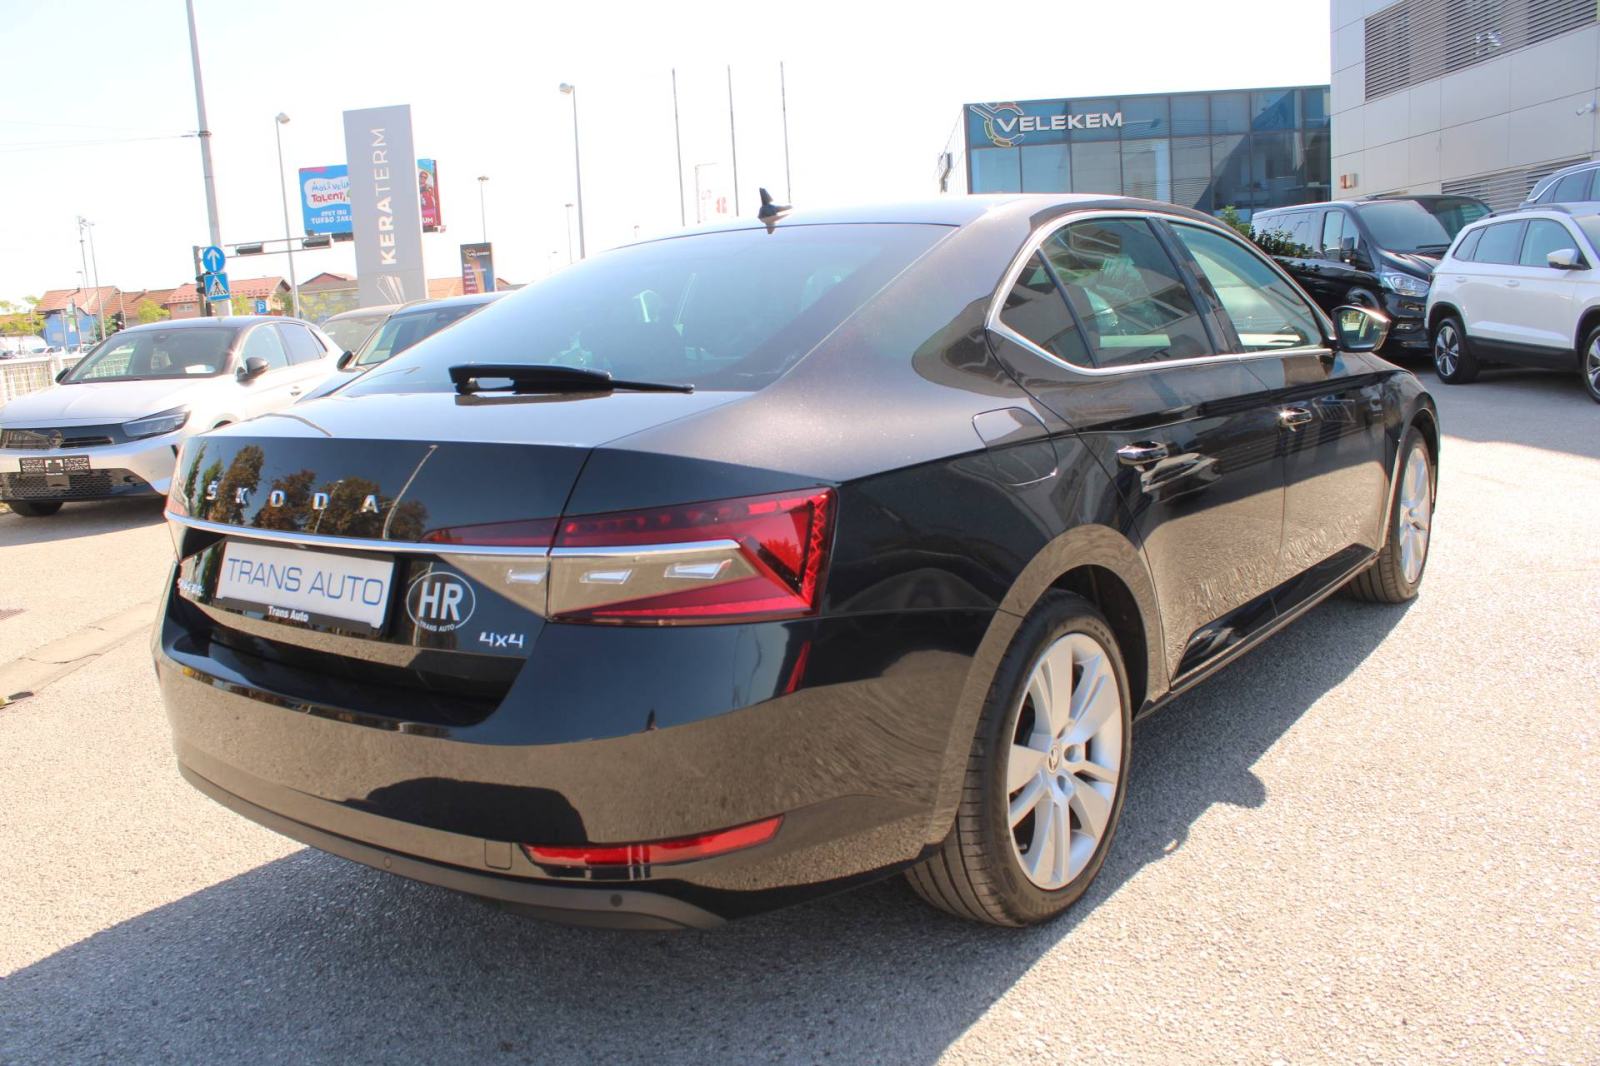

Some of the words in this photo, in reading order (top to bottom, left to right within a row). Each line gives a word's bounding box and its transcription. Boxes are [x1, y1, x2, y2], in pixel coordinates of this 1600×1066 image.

[996, 111, 1122, 132] VELEKEM
[370, 128, 397, 264] KERATERM
[228, 557, 303, 593] TRANS
[308, 570, 384, 606] AUTO
[418, 580, 464, 621] HR
[268, 605, 289, 619] Trans
[289, 609, 309, 623] Auto
[438, 624, 455, 633] AUTO
[479, 631, 524, 648] 4x4
